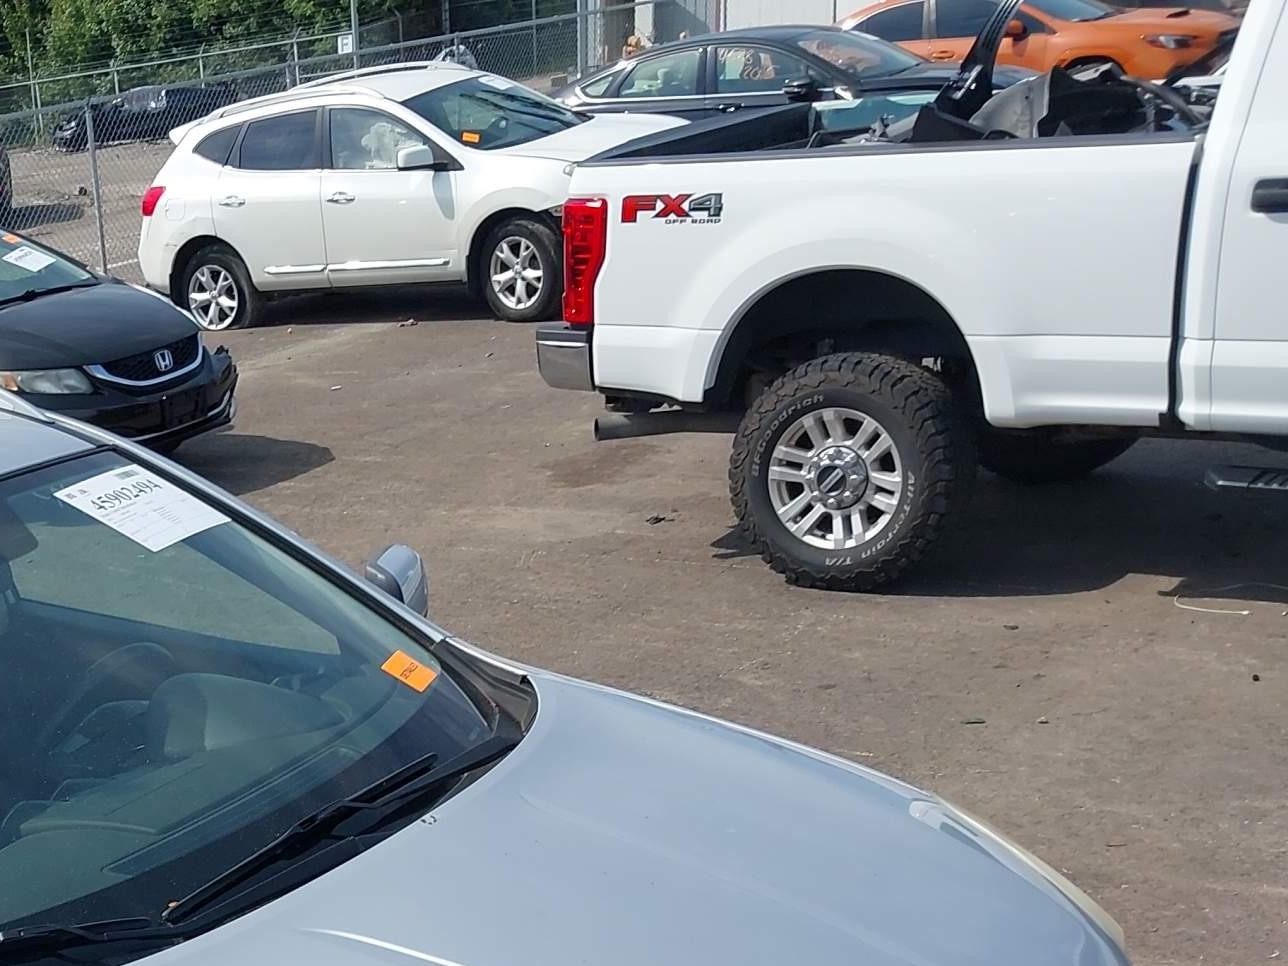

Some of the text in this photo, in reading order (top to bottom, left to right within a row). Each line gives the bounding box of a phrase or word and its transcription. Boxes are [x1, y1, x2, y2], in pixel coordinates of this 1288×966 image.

[621, 193, 723, 223] FX4
[752, 395, 824, 477] BFGoodrich
[90, 479, 163, 511] 45902494
